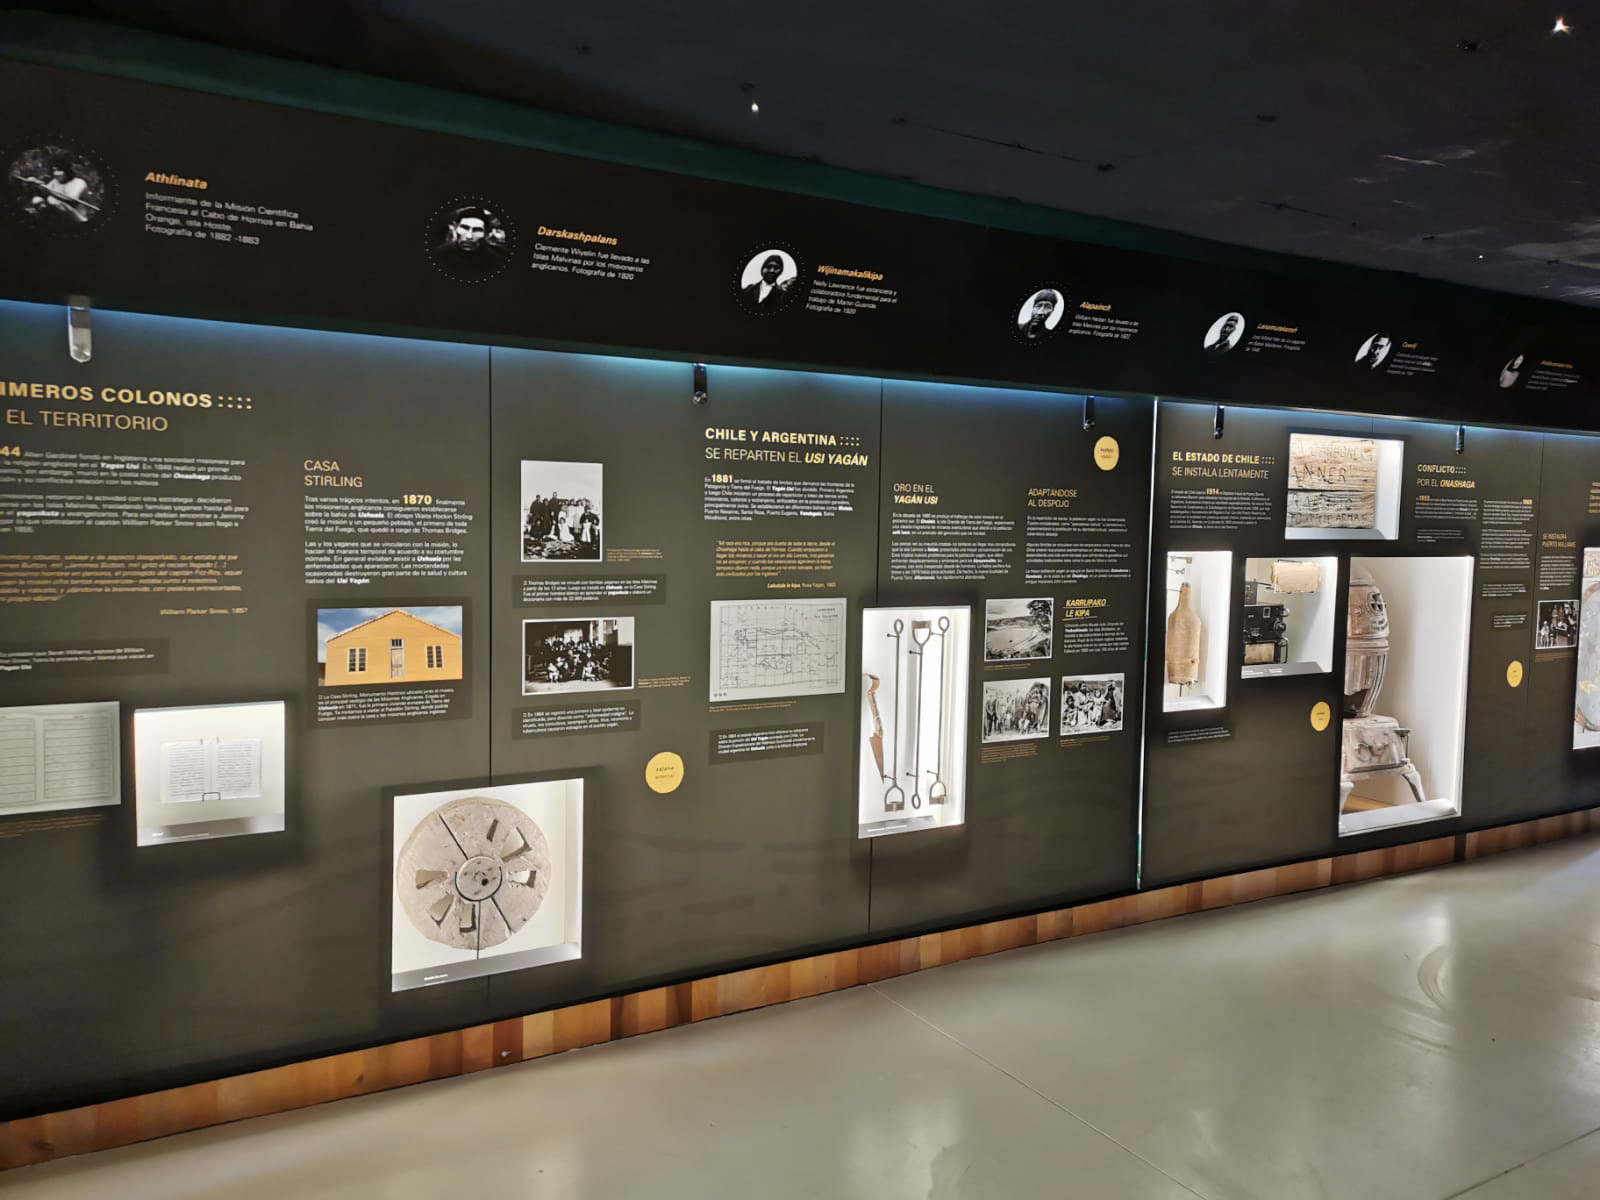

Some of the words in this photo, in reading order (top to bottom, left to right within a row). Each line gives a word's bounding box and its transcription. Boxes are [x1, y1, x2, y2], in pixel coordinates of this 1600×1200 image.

[144, 171, 208, 189] Athlinata
[101, 387, 213, 408] COLONOS
[6, 409, 32, 425] EL
[39, 410, 169, 432] TERRITORIO
[705, 427, 747, 441] CHILE
[750, 430, 759, 442] Y
[762, 431, 837, 446] ARGENTINA
[705, 447, 720, 459] SE
[724, 448, 785, 462] REPARTEN
[788, 451, 802, 463] EL
[805, 452, 825, 464] USI
[828, 452, 868, 466] YAGÁN
[1172, 451, 1183, 461] EL
[1185, 452, 1220, 462] ESTADO
[1221, 454, 1233, 463] DE
[1235, 454, 1259, 464] CHILE
[304, 460, 340, 471] CASA
[1417, 464, 1455, 473] CONFLICTO
[1172, 466, 1183, 476] SE
[1184, 467, 1217, 477] INSTALA
[1219, 468, 1269, 479] LENTAMENTE
[304, 475, 363, 487] STIRLING
[712, 474, 733, 483] 1881
[1417, 478, 1429, 486] POR
[1431, 479, 1438, 487] EL
[1440, 480, 1476, 488] ONASHAGA
[893, 483, 911, 492] ORO
[913, 484, 923, 492] EN
[925, 484, 934, 493] EL
[403, 494, 432, 504] 1870
[894, 494, 923, 504] YAGÁN
[924, 495, 939, 504] USI
[1028, 499, 1036, 507] AL
[1038, 499, 1070, 508] DESPOJO
